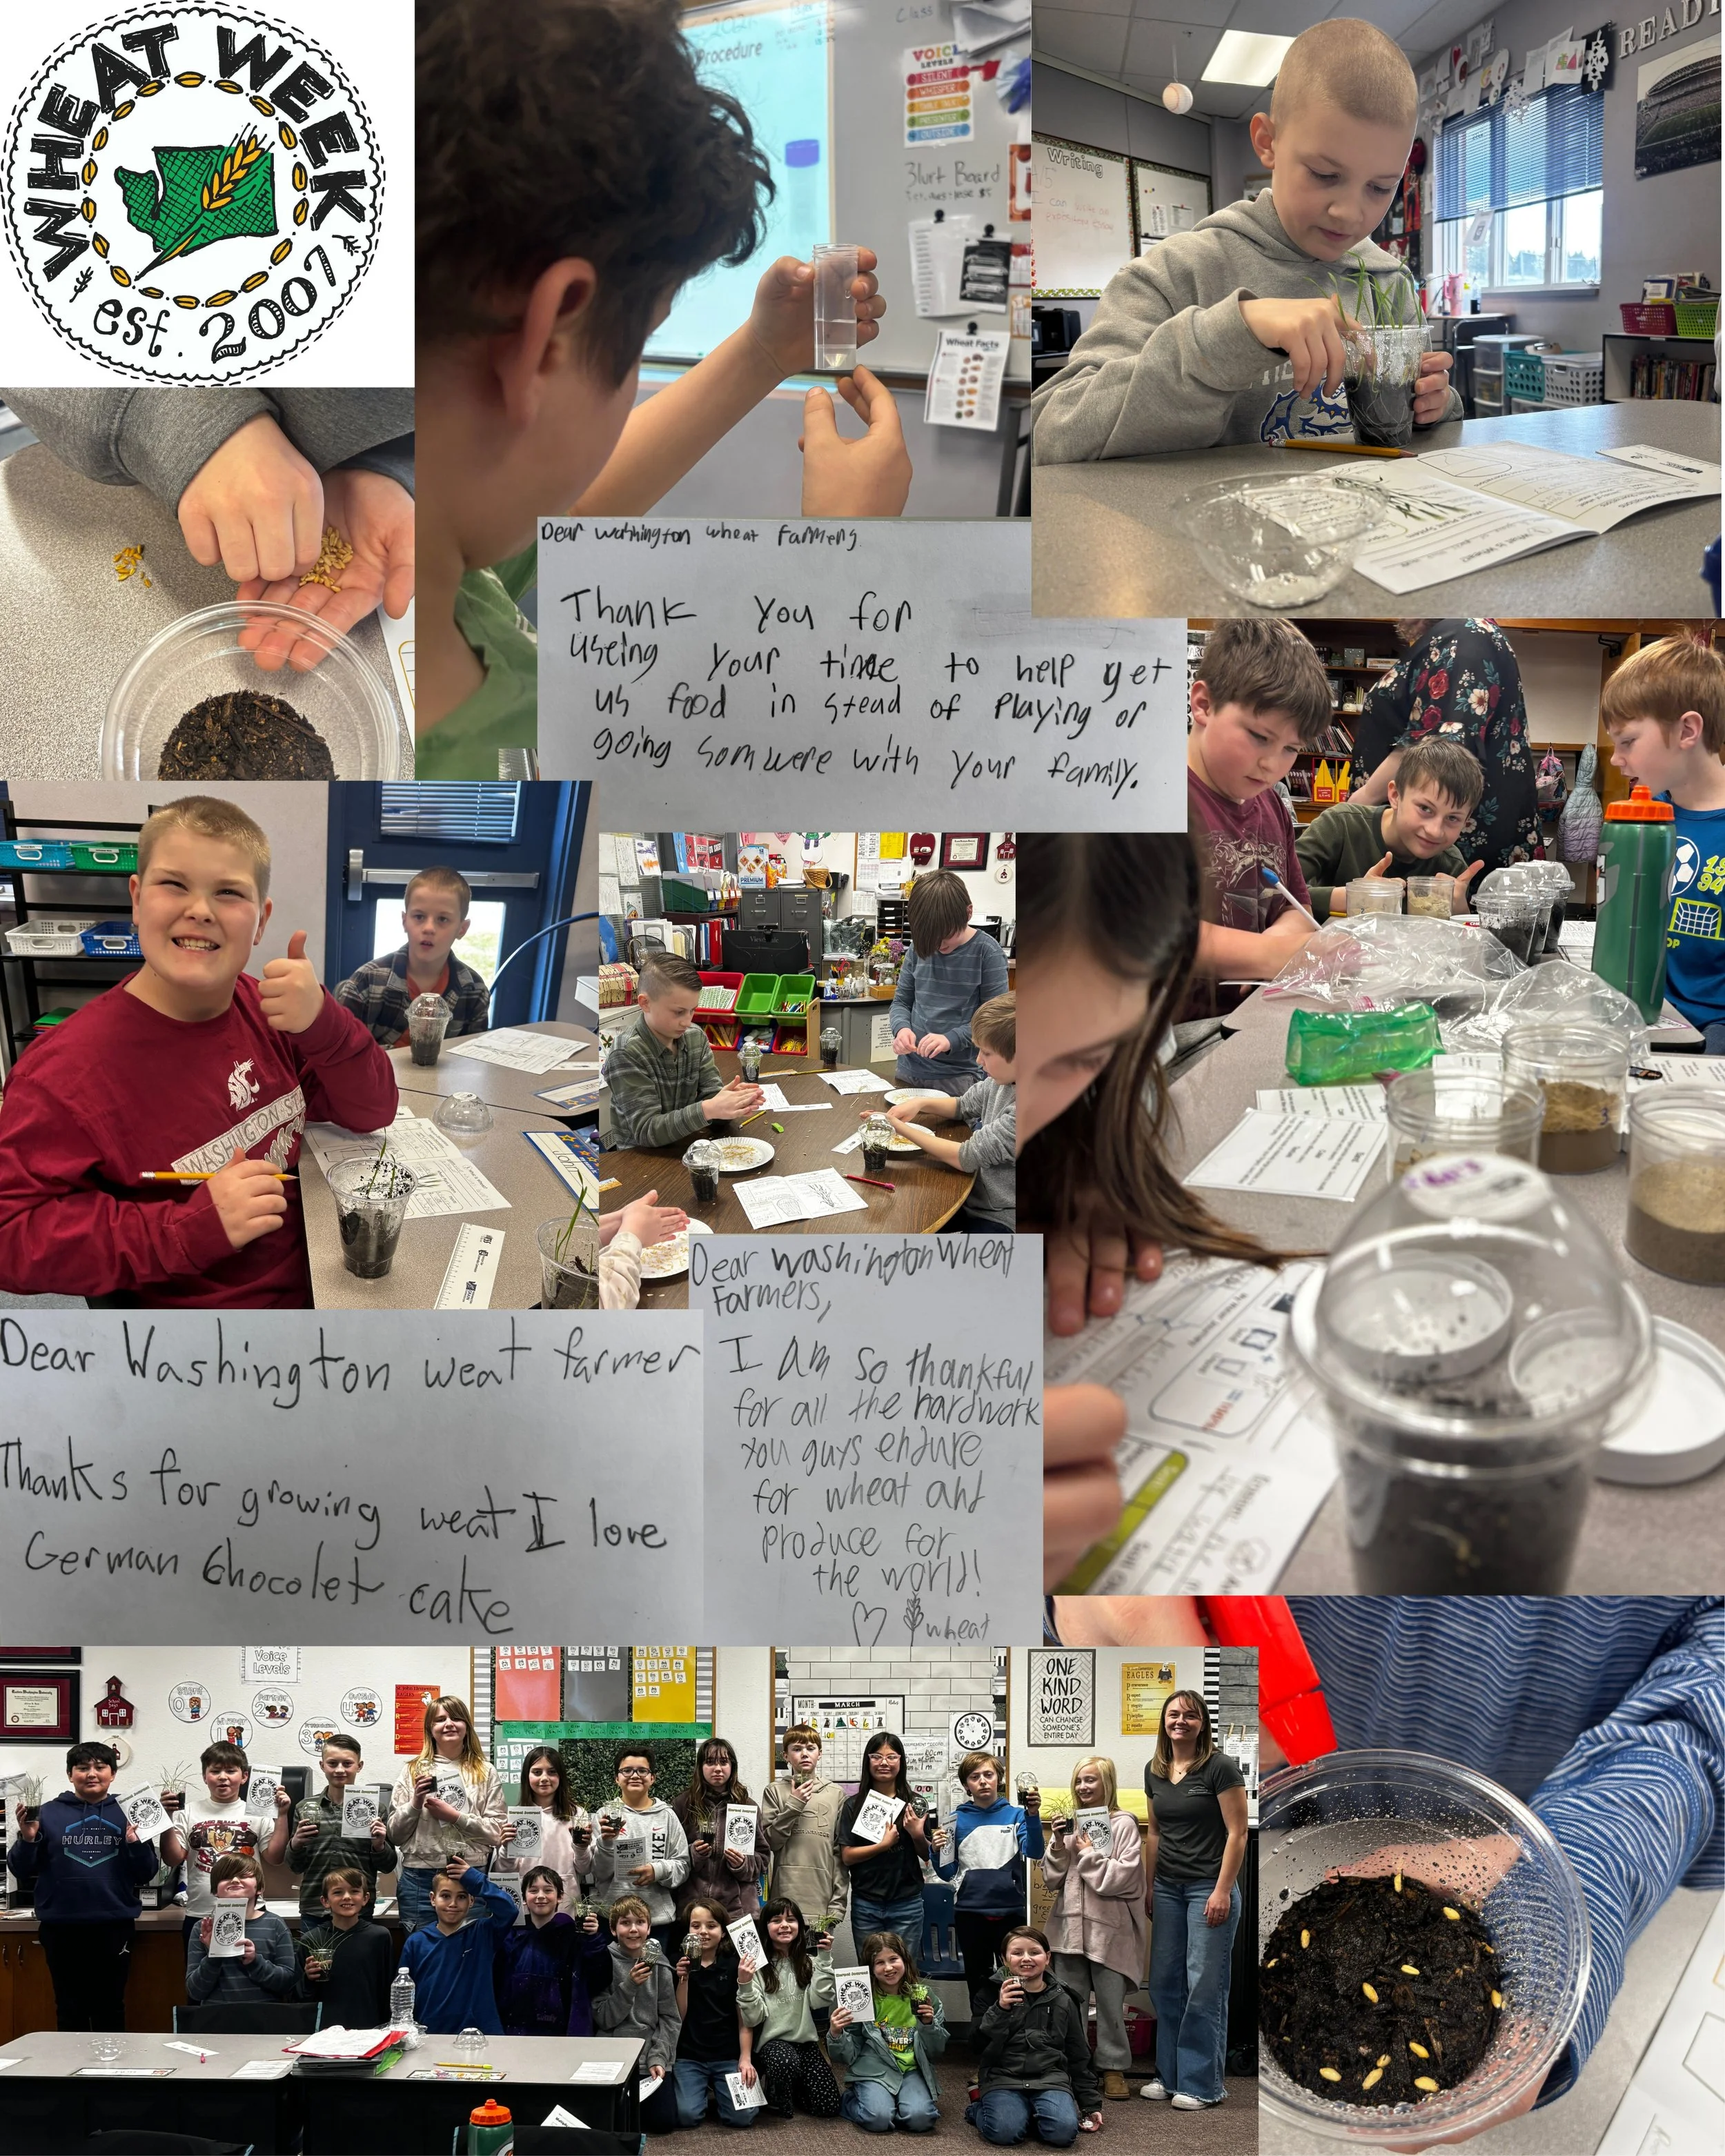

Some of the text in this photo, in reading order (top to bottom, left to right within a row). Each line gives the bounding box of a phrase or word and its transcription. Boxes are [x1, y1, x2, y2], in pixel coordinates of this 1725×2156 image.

[696, 42, 763, 66] Procedure
[954, 160, 999, 186] Board
[1047, 148, 1103, 178] Writing
[1049, 197, 1067, 208] can
[946, 337, 999, 348] Wheat Facts
[541, 522, 584, 543] Dear
[705, 522, 760, 543] wheat
[559, 585, 698, 630] Thank
[849, 590, 912, 634] for
[569, 631, 658, 684] useing
[945, 651, 980, 680] to
[1101, 657, 1173, 704] get
[595, 684, 630, 718] us
[667, 679, 727, 720] food
[770, 682, 796, 718] in
[823, 685, 902, 724] stead
[929, 693, 962, 722] of
[1115, 700, 1147, 728] or
[593, 726, 672, 769] going
[853, 733, 919, 775] with
[1047, 751, 1138, 800] family.
[1697, 873, 1722, 895] 94
[1600, 1107, 1609, 1126] 3
[182, 1104, 280, 1174] WASHINGTON
[552, 1150, 579, 1174] John
[691, 1242, 759, 1287] Dear
[936, 1233, 1015, 1278] Wheat
[711, 1276, 832, 1324] Farmers,
[0, 1316, 701, 1410] Dear Washington weat farmer
[718, 1334, 764, 1374] I
[905, 1342, 1034, 1398] thankful
[733, 1383, 1040, 1428] for all the hardwork
[801, 1434, 862, 1478] guys
[0, 1435, 668, 1554] Thanks for growing weat I love
[752, 1478, 799, 1516] for
[826, 1470, 910, 1513] wheat
[762, 1521, 954, 1564] produce for
[25, 1530, 179, 1576] German
[408, 1554, 514, 1635] cake
[812, 1546, 981, 1599] the world!
[925, 1613, 990, 1640] wheat
[255, 1650, 287, 1662] Voice
[253, 1663, 290, 1674] Levels
[1046, 1657, 1078, 1676] ONE
[177, 1685, 203, 1696] Silent
[348, 1692, 375, 1701] Outside
[1043, 1677, 1081, 1696] KIND
[173, 1697, 185, 1712] 0
[258, 1694, 288, 1702] Partner
[798, 1700, 816, 1709] MONTH:
[1041, 1698, 1083, 1714] WORD
[255, 1701, 266, 1717] 2
[343, 1701, 354, 1717] 4
[302, 1729, 312, 1745] 3
[251, 1779, 266, 1799] WHEAT
[448, 1785, 464, 1799] WEEK
[141, 1799, 160, 1810] WEEK
[346, 1799, 376, 1819] WHEAT WEEK
[526, 1819, 539, 1839] WEEK
[728, 1817, 741, 1837] WHEAT
[743, 1819, 753, 1834] WEEK
[1094, 1821, 1110, 1837] WEEK
[61, 1834, 123, 1846] HURLEY
[216, 1913, 241, 1937] WHEAT WEEK
[840, 1981, 869, 2004] WHEAT WEEK
[856, 1999, 868, 2010] 2007
